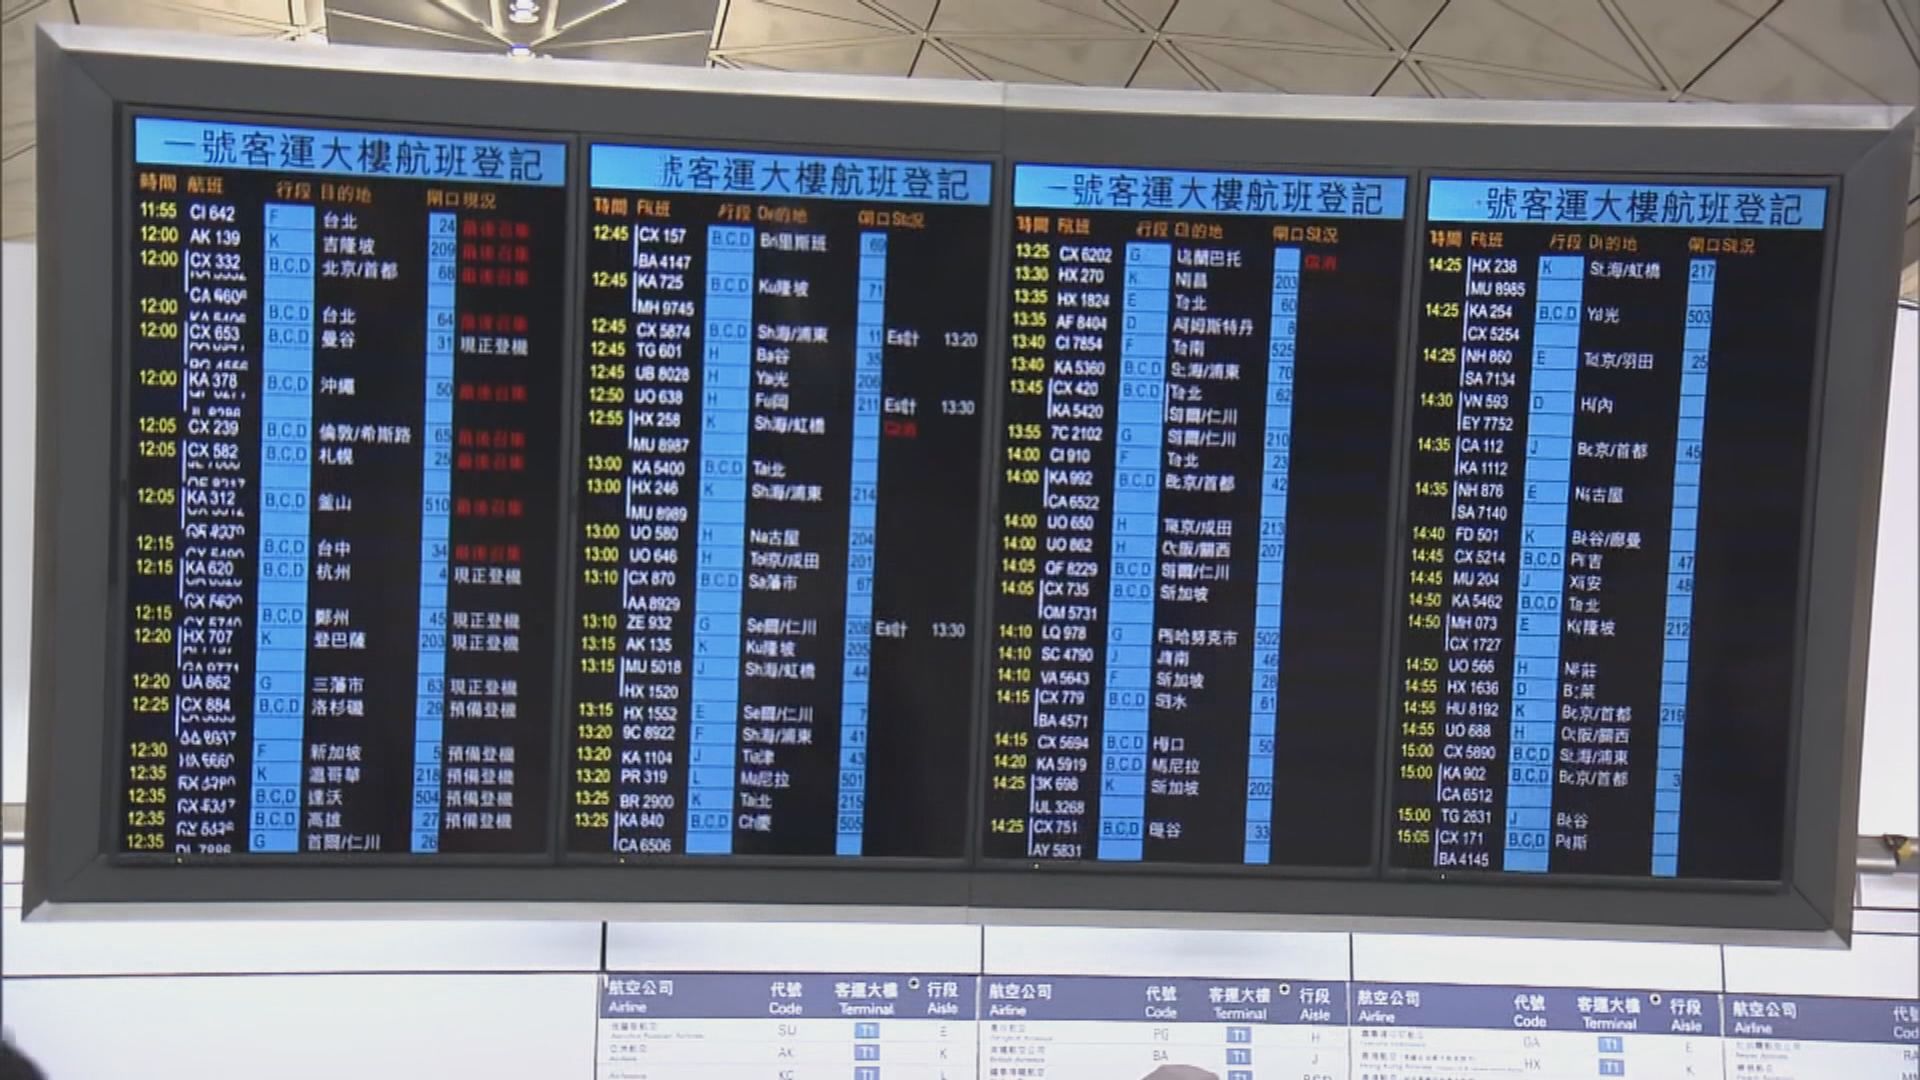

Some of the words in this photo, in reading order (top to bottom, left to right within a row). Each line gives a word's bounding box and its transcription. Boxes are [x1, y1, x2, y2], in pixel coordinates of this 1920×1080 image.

[164, 129, 543, 182] 一號客運大樓航班登記
[1047, 173, 1383, 216] 一號客運大樓航班登記
[141, 202, 177, 218] 11:55
[190, 205, 206, 220] CI
[209, 206, 235, 222] 642
[322, 211, 358, 230] 台北
[141, 226, 178, 242] 12:00
[190, 230, 210, 245] AK
[216, 231, 241, 246] 139
[270, 234, 280, 248] K
[593, 225, 629, 241] 12:45
[639, 226, 659, 241] CX
[663, 229, 686, 244] 157
[141, 251, 178, 267] 12:00
[190, 254, 211, 268] CX
[215, 255, 241, 269] 332
[322, 262, 398, 280] 北京/首都
[639, 254, 658, 268] BA
[660, 256, 691, 270] 4147
[1429, 258, 1462, 272] 14:25
[1472, 260, 1491, 273] HX
[1494, 260, 1517, 274] 238
[1015, 266, 1048, 281] 13:30
[1058, 268, 1078, 283] HX
[1080, 269, 1104, 283] 270
[140, 323, 177, 339] 12:00
[190, 326, 211, 340] CX
[214, 327, 240, 341] 653
[321, 331, 355, 349] 曼谷
[460, 337, 528, 355] 現正登機
[944, 332, 978, 347] 13:20
[591, 341, 625, 356] 12:45
[636, 343, 656, 358] TG
[659, 344, 682, 358] 601
[1465, 372, 1483, 386] SA
[1486, 372, 1516, 386] 7134
[139, 418, 176, 433] 12:05
[188, 420, 210, 435] CX
[213, 421, 239, 436] 239
[1008, 424, 1042, 439] 13:55
[1051, 426, 1069, 440] 7C
[1072, 427, 1102, 441] 2102
[1418, 438, 1450, 452] 14:35
[1461, 439, 1480, 452] CA
[1483, 439, 1504, 453] 112
[1008, 447, 1040, 461] 14:00
[1050, 448, 1064, 462] CI
[1067, 449, 1090, 463] 910
[1459, 461, 1478, 474] KA
[1482, 461, 1508, 476] 1112
[137, 489, 175, 504] 12:05
[187, 491, 207, 505] KA
[210, 492, 235, 506] 312
[586, 524, 620, 540] 13:00
[630, 526, 651, 540] UO
[655, 526, 679, 541] 580
[1413, 526, 1445, 542] 14:40
[1456, 527, 1474, 541] FD
[1477, 528, 1499, 542] 501
[136, 560, 173, 575] 12:15
[186, 561, 206, 574] KA
[208, 562, 233, 576] 620
[317, 564, 350, 581] 杭州
[454, 568, 522, 585] 現正登機
[1408, 615, 1441, 629] 14:50
[1452, 616, 1472, 629] MH
[1475, 617, 1497, 630] 073
[135, 629, 171, 644] 12:20
[183, 630, 204, 643] HX
[209, 630, 233, 644] 707
[452, 635, 519, 652] 現正登機
[1000, 624, 1032, 639] 14:10
[1042, 625, 1061, 640] LQ
[1064, 626, 1087, 640] 978
[582, 637, 616, 650] 13:15
[626, 638, 645, 652] AK
[651, 639, 672, 652] 135
[133, 674, 170, 689] 12:20
[182, 675, 203, 688] UA
[312, 677, 364, 694] 三藩市
[130, 742, 168, 758] 12:30
[311, 744, 362, 762] 新加坡
[448, 746, 515, 763] 預備登機
[994, 754, 1027, 768] 14:20
[1037, 758, 1055, 771] KA
[1057, 758, 1087, 772] 5919
[576, 769, 611, 783] 13:20
[621, 770, 641, 784] PR
[644, 770, 667, 784] 319
[127, 811, 165, 827] 12:35
[445, 812, 512, 829] 預備登機
[991, 819, 1024, 833] 14:25
[1034, 820, 1054, 833] CX
[1056, 821, 1077, 834] 751
[127, 834, 164, 849] 12:35
[307, 834, 381, 850] 首爾/仁川
[619, 838, 638, 852] CA
[640, 839, 672, 852] 6506
[1398, 830, 1429, 843] 15:05
[1440, 831, 1458, 844] CX
[1464, 832, 1483, 845] 171
[1439, 852, 1456, 865] BA
[1459, 853, 1488, 866] 4145
[608, 980, 673, 995] 航空公司
[770, 982, 802, 997] 代號
[928, 982, 958, 998] 行段
[989, 984, 1052, 999] 航空公司
[1146, 986, 1177, 1001] 代號
[1300, 988, 1331, 1004] 行段
[608, 1002, 646, 1013] Airline
[769, 1002, 802, 1014] Code
[839, 1003, 894, 1015] Terminal
[928, 1003, 958, 1015] Aisle
[1358, 990, 1420, 1007] 航空公司
[1514, 994, 1545, 1011] 代號
[1670, 998, 1702, 1016] 行段
[989, 1004, 1026, 1017] Airline
[1145, 1006, 1177, 1019] Code
[1214, 1006, 1266, 1021] Terminal
[1301, 1009, 1331, 1021] Aisle
[1359, 1010, 1395, 1023] Airline
[1514, 1015, 1546, 1027] Code
[1583, 1016, 1638, 1031] Terminal
[1672, 1019, 1702, 1033] Aisle
[1735, 1022, 1772, 1034] Airline
[1153, 1051, 1168, 1061] BA
[1525, 1059, 1540, 1070] HX
